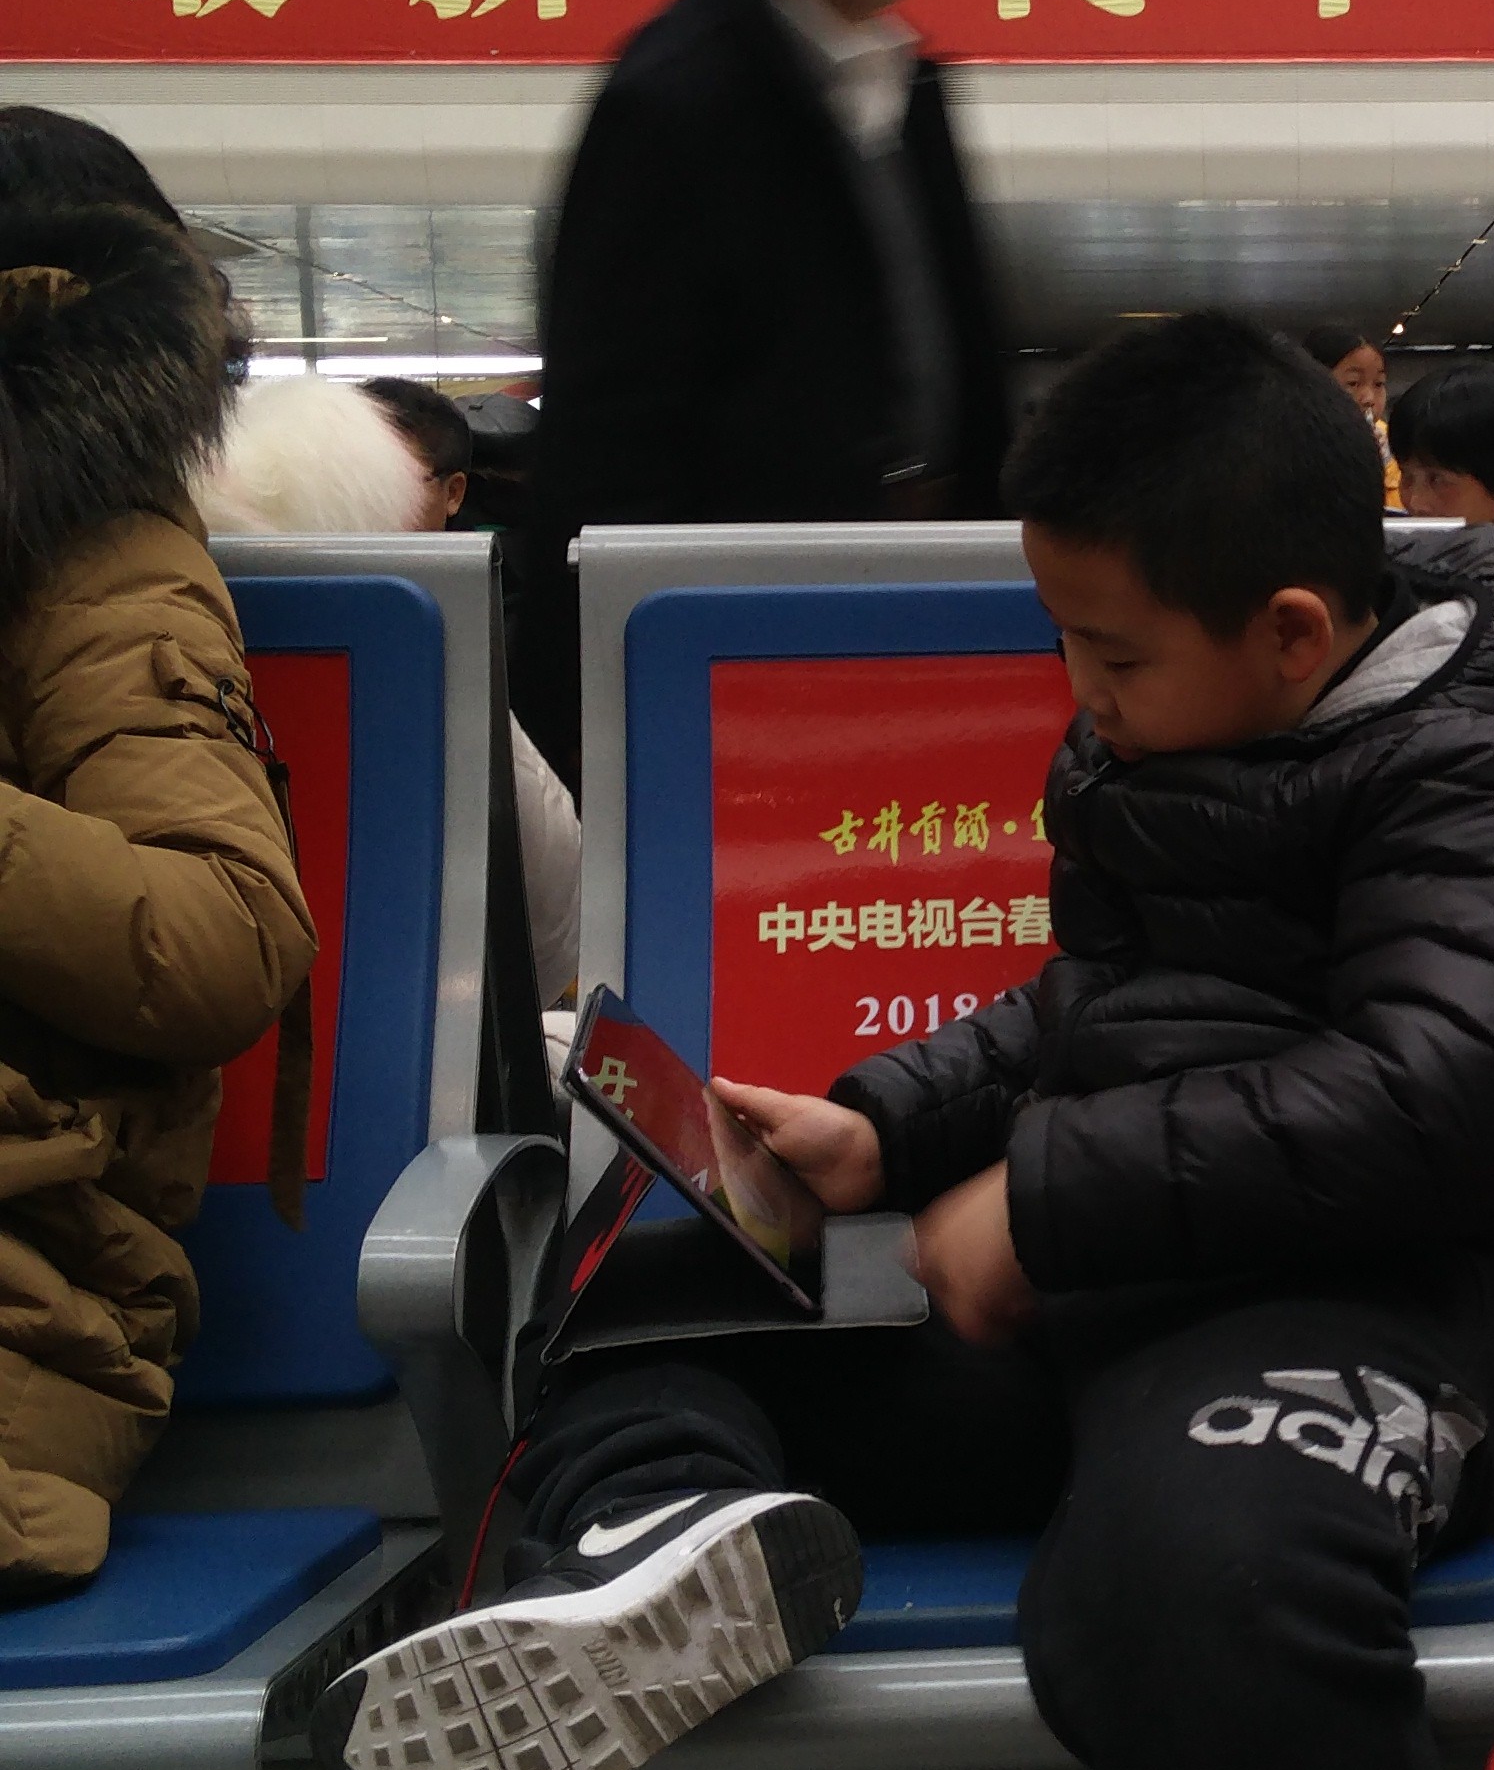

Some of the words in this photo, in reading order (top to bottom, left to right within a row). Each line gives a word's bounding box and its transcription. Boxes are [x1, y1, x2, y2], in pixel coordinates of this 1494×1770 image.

[757, 894, 1052, 955] 中央电视台春
[853, 989, 1006, 1036] 2018
